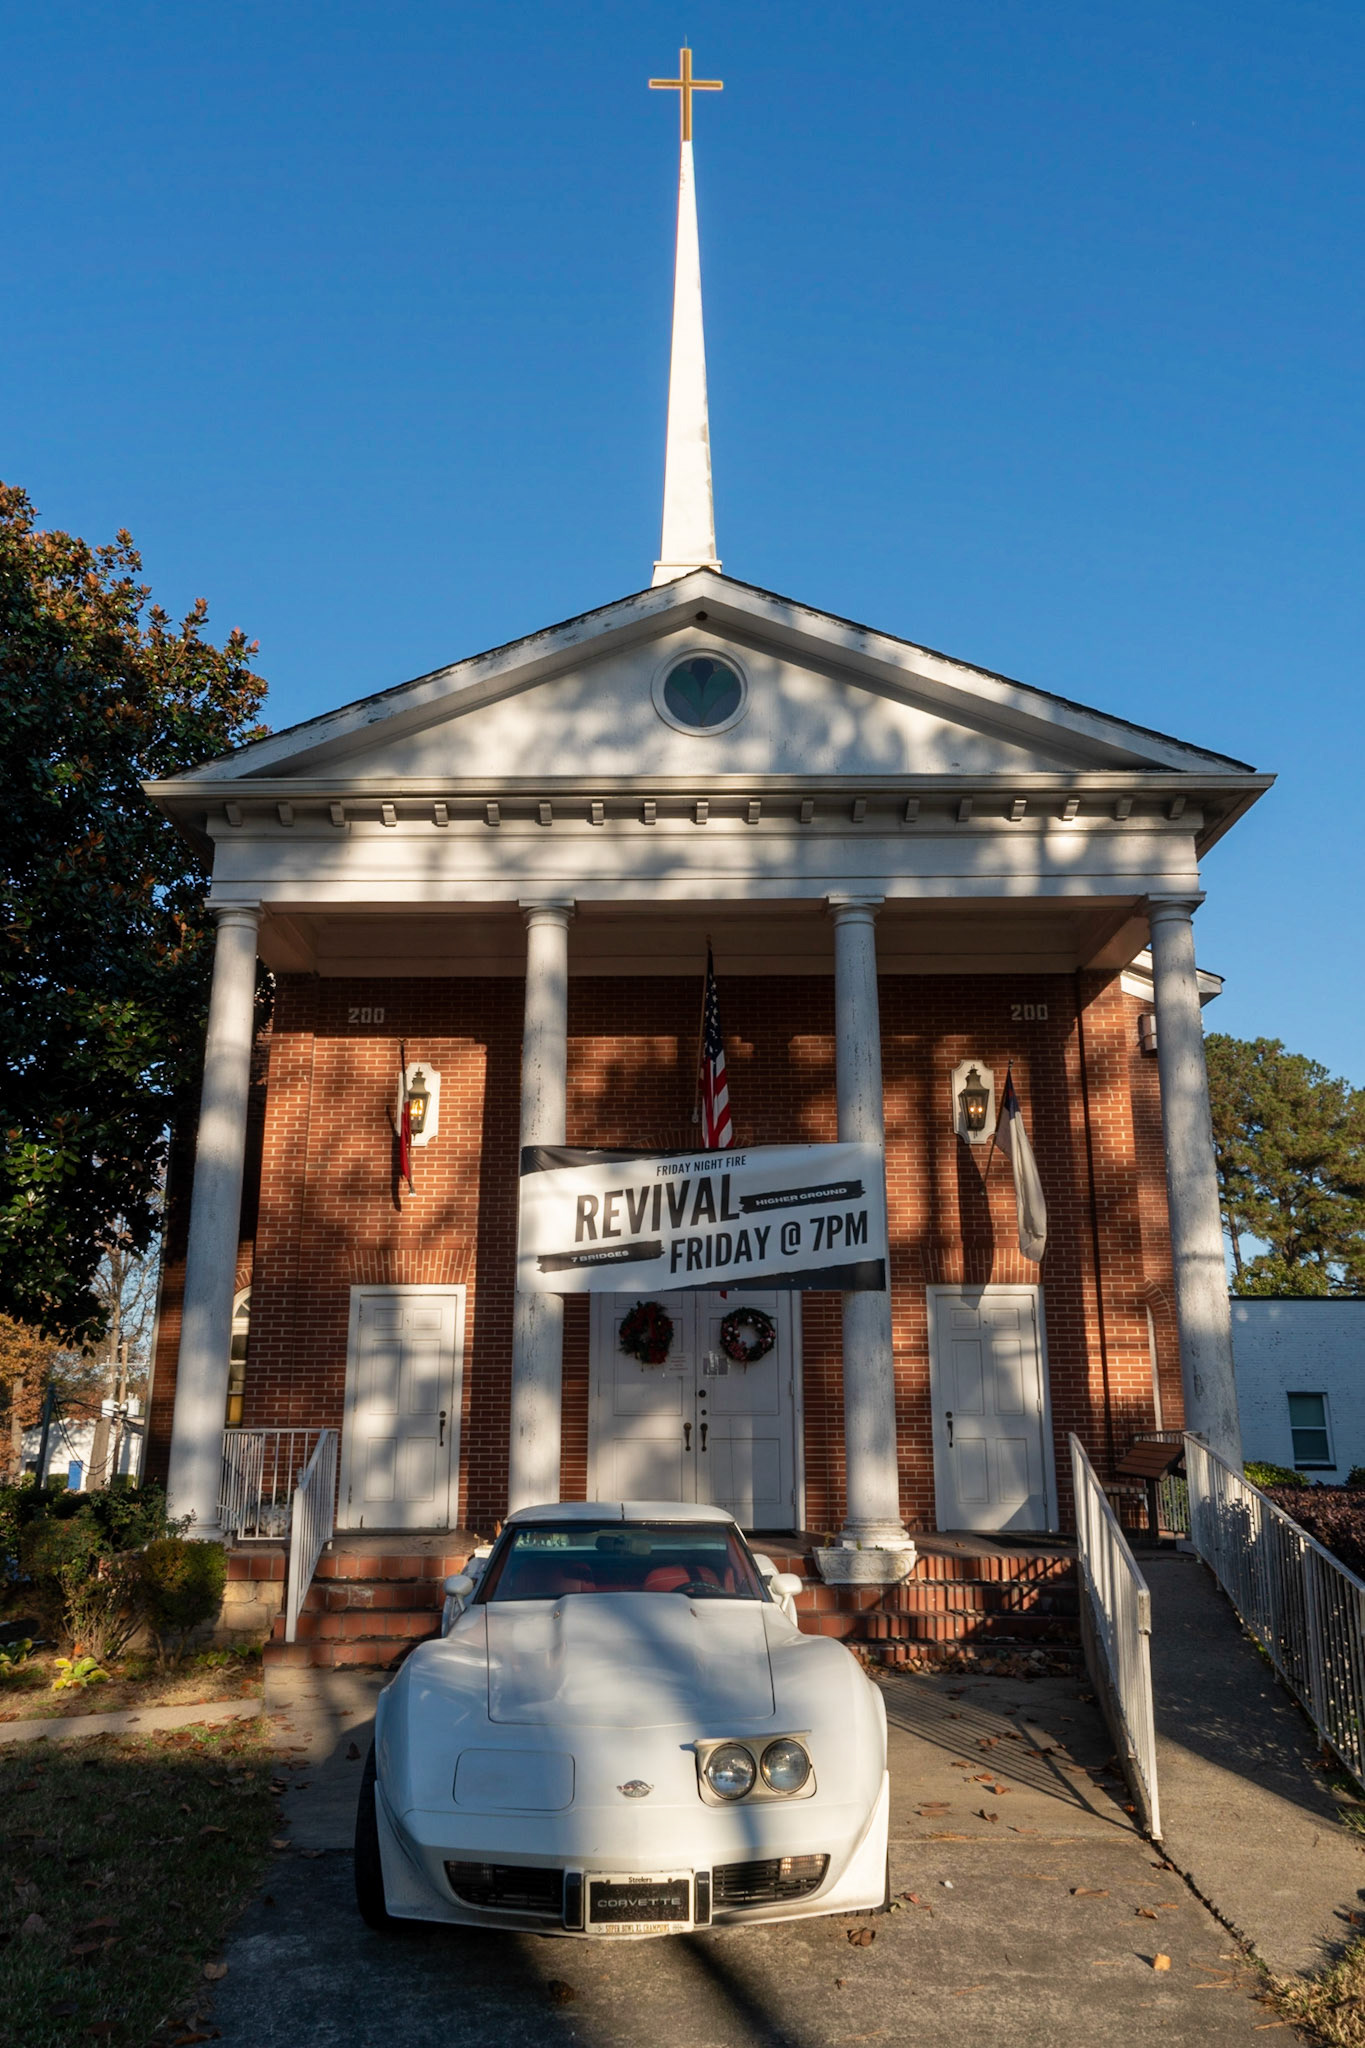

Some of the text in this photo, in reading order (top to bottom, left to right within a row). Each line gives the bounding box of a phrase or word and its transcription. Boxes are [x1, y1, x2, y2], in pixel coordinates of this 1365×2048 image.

[348, 1007, 385, 1024] 200
[1010, 1004, 1048, 1021] 200
[656, 1155, 747, 1177] FRIDAY NIGHT FIRE
[755, 1187, 848, 1206] HIGHER GROUND
[574, 1173, 740, 1243] REVIVAL
[670, 1210, 868, 1274] FRIDAY @ 7PM
[579, 1250, 630, 1262] BRIDGES
[597, 1897, 682, 1908] CORVETTE
